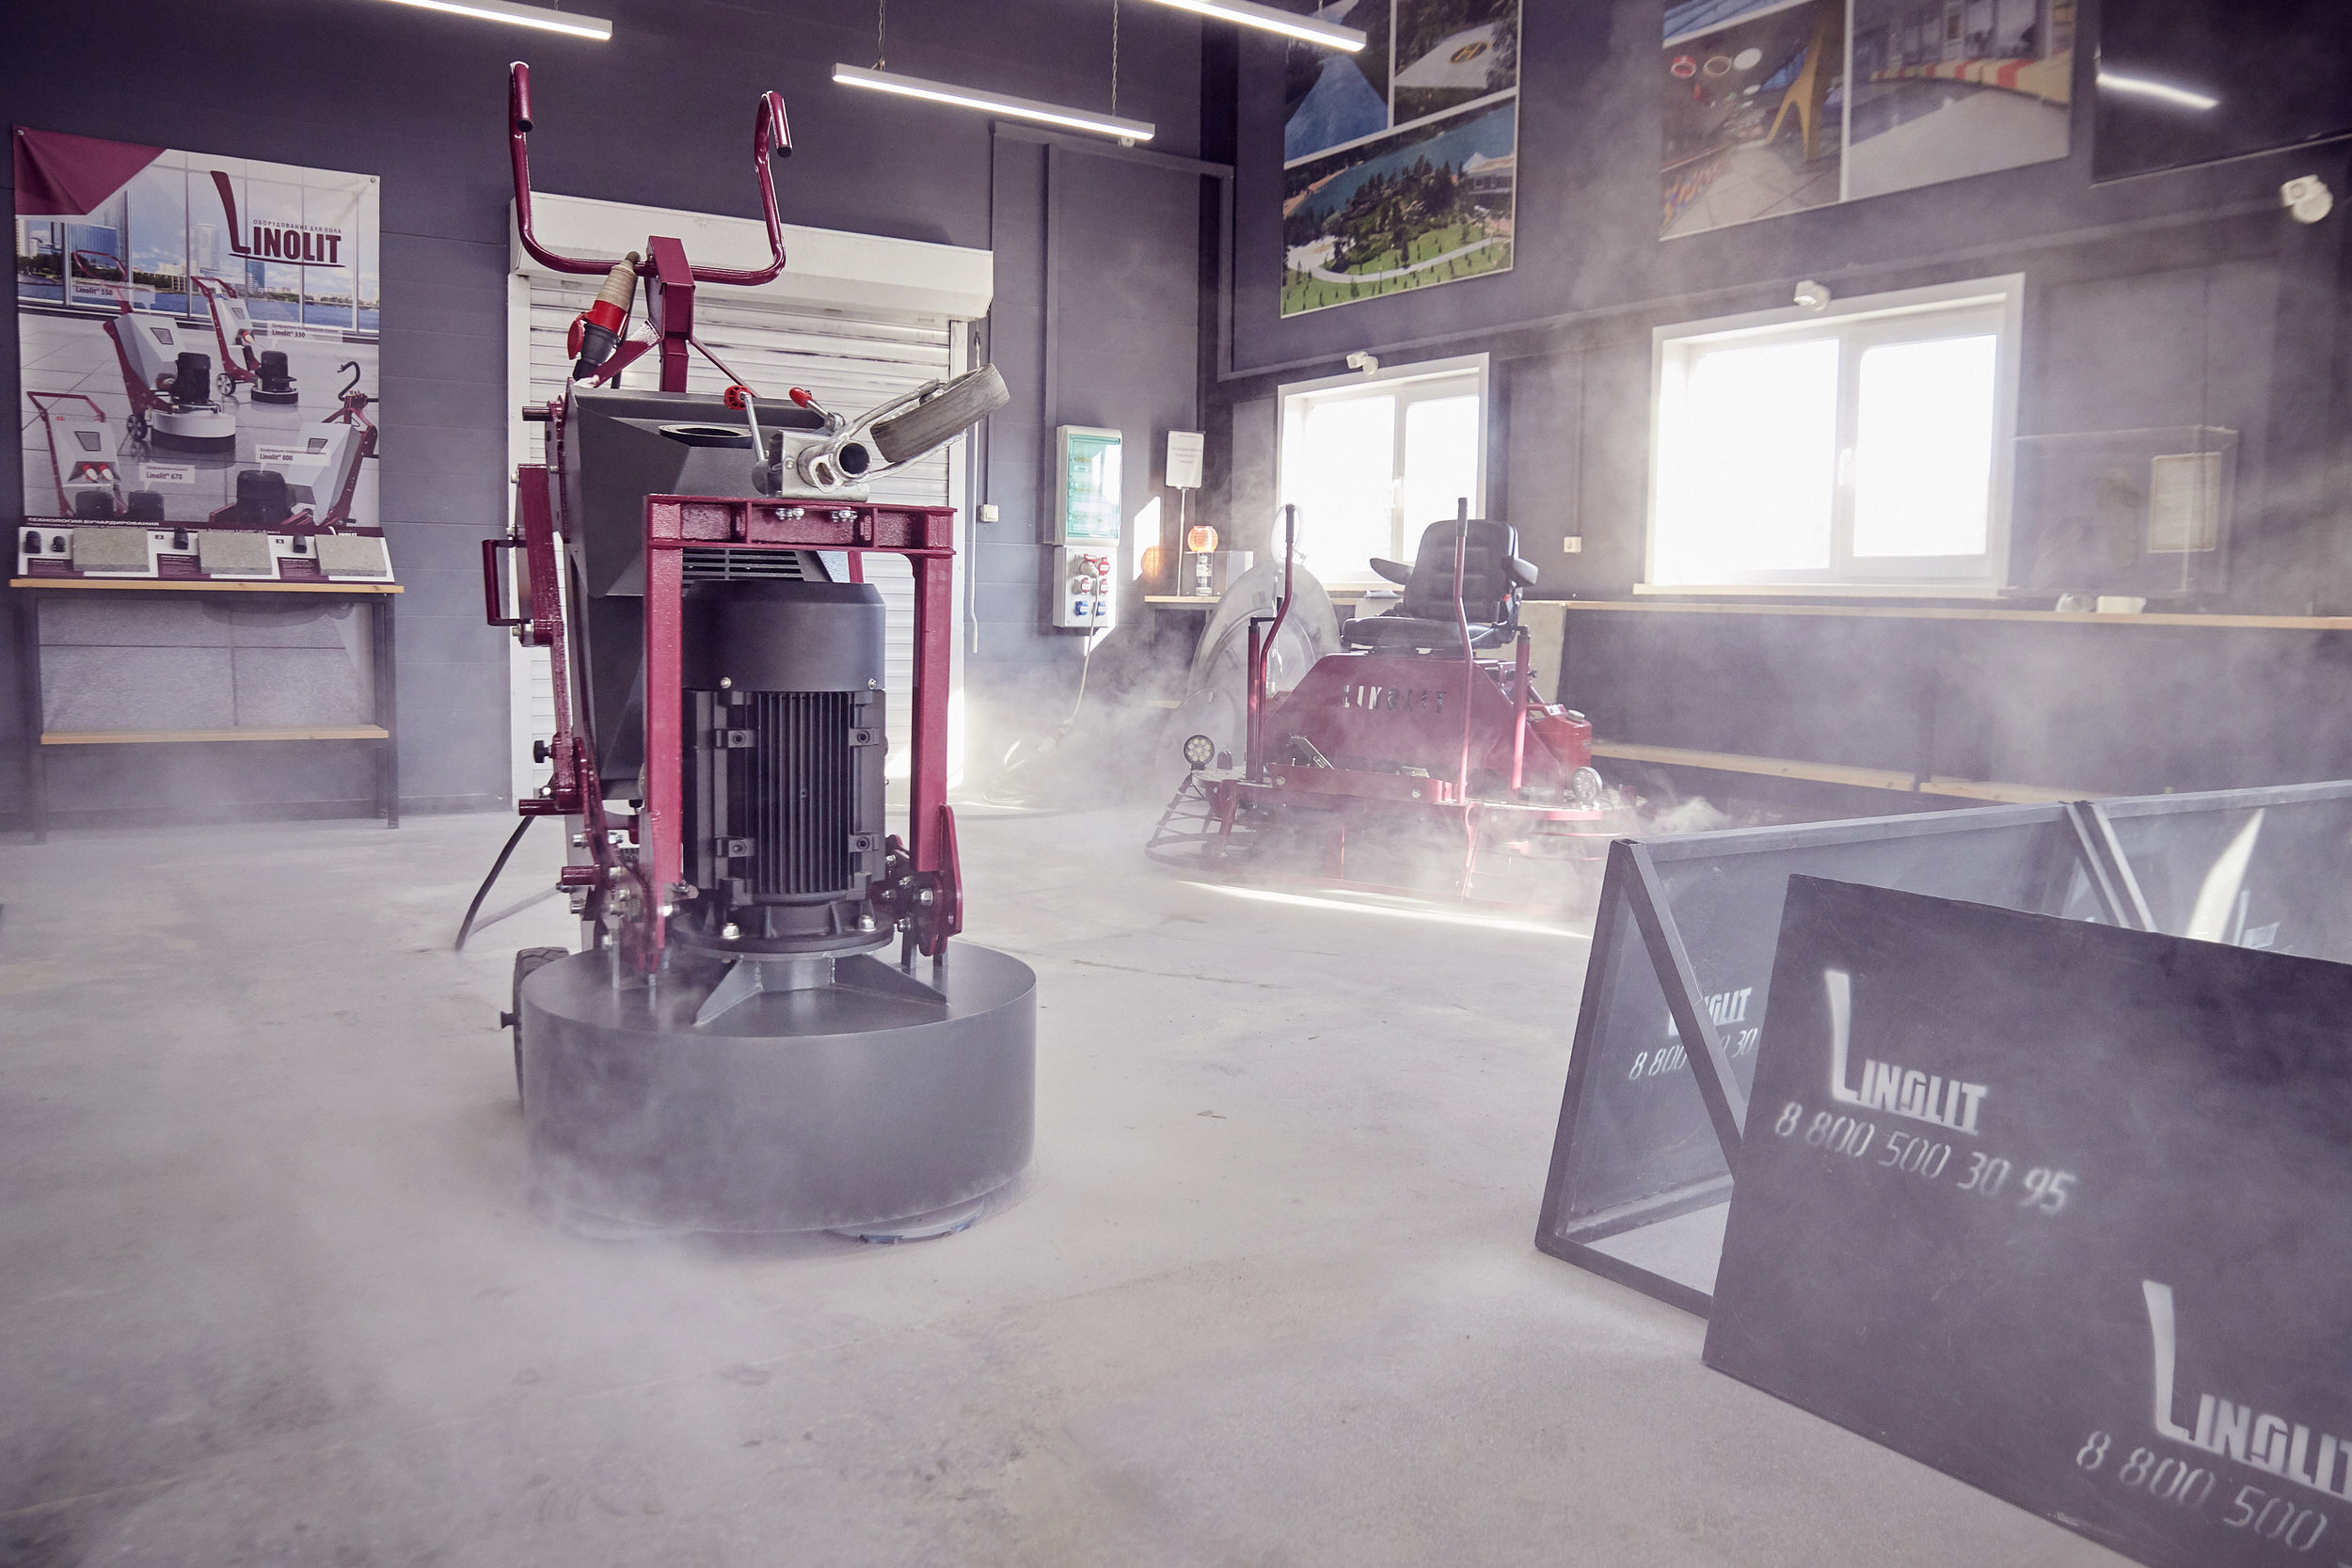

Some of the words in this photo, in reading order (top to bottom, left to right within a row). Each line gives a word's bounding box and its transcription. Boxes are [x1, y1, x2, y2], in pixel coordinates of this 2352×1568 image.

[210, 170, 342, 263] LINOLIT
[253, 218, 308, 230] ОБОРУДОВАНИЕ
[1629, 1051, 1648, 1080] 8
[1648, 1044, 1688, 1076] 800
[1730, 1027, 1758, 1058] 30
[1775, 1101, 1803, 1137] 8
[1805, 1111, 1875, 1157] 800
[1879, 1131, 1952, 1179] 500
[1956, 1151, 2010, 1196] 30
[2019, 1168, 2077, 1215] 95
[2076, 1431, 2111, 1471] 8
[2119, 1448, 2217, 1507] 800
[2223, 1484, 2328, 1551] 500
